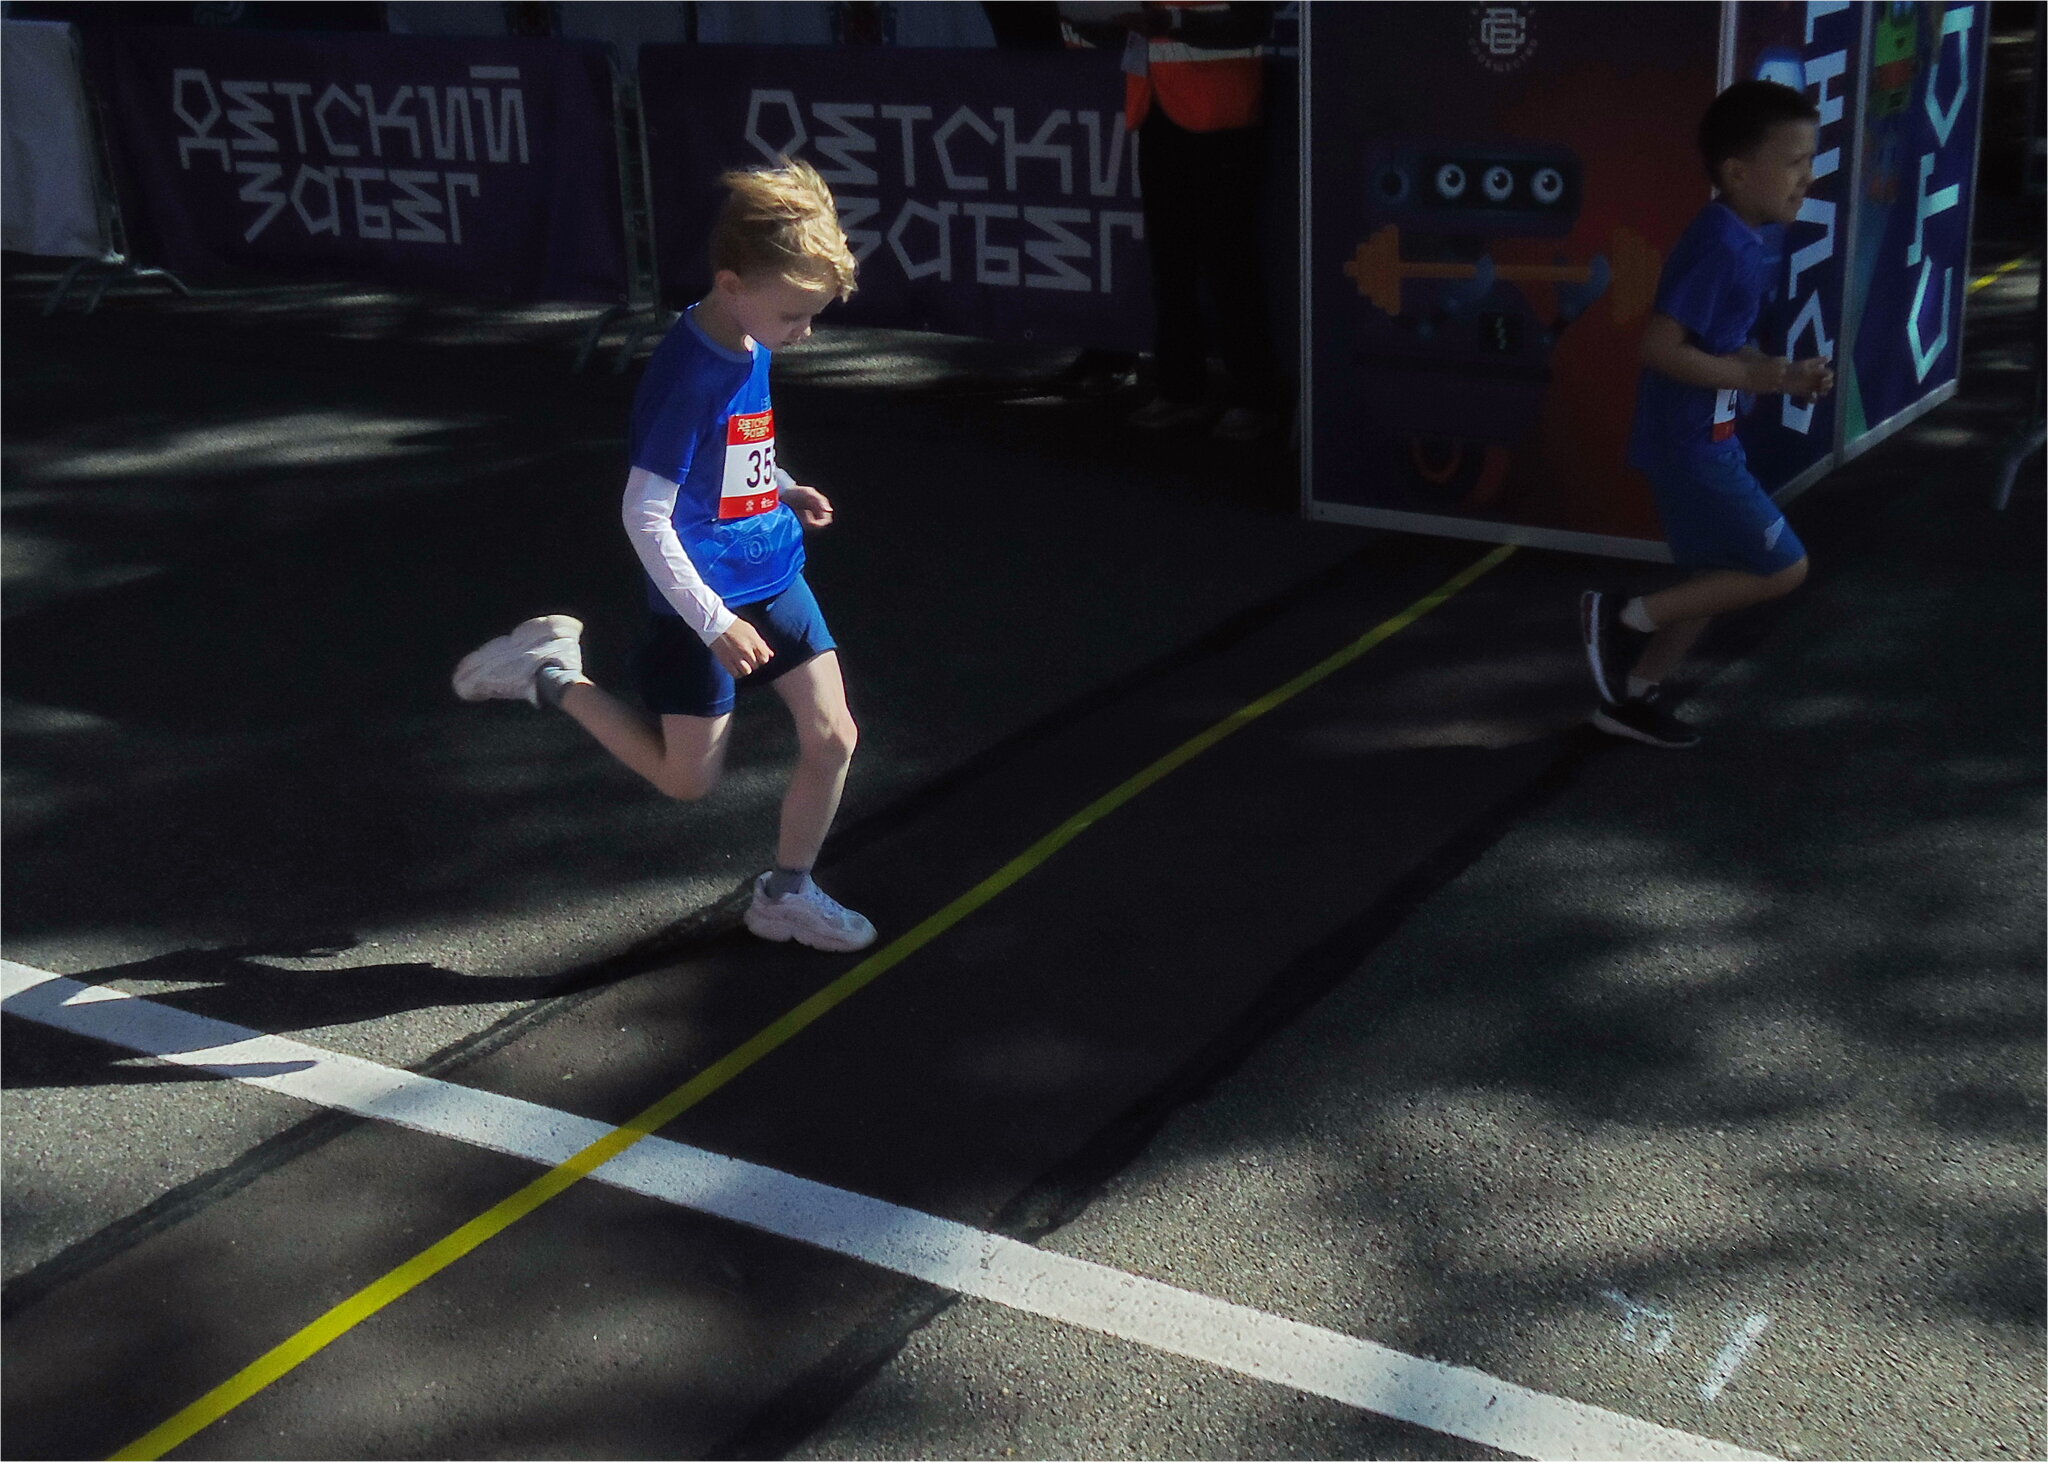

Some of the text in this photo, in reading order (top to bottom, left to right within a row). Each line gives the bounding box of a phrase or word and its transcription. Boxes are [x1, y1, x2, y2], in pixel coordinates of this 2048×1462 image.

[172, 66, 529, 172] ДЕТСКИЙ
[744, 89, 1143, 198] ДЕТСКИ
[237, 160, 480, 244] ЗАБЕГ
[747, 446, 775, 489] 35
